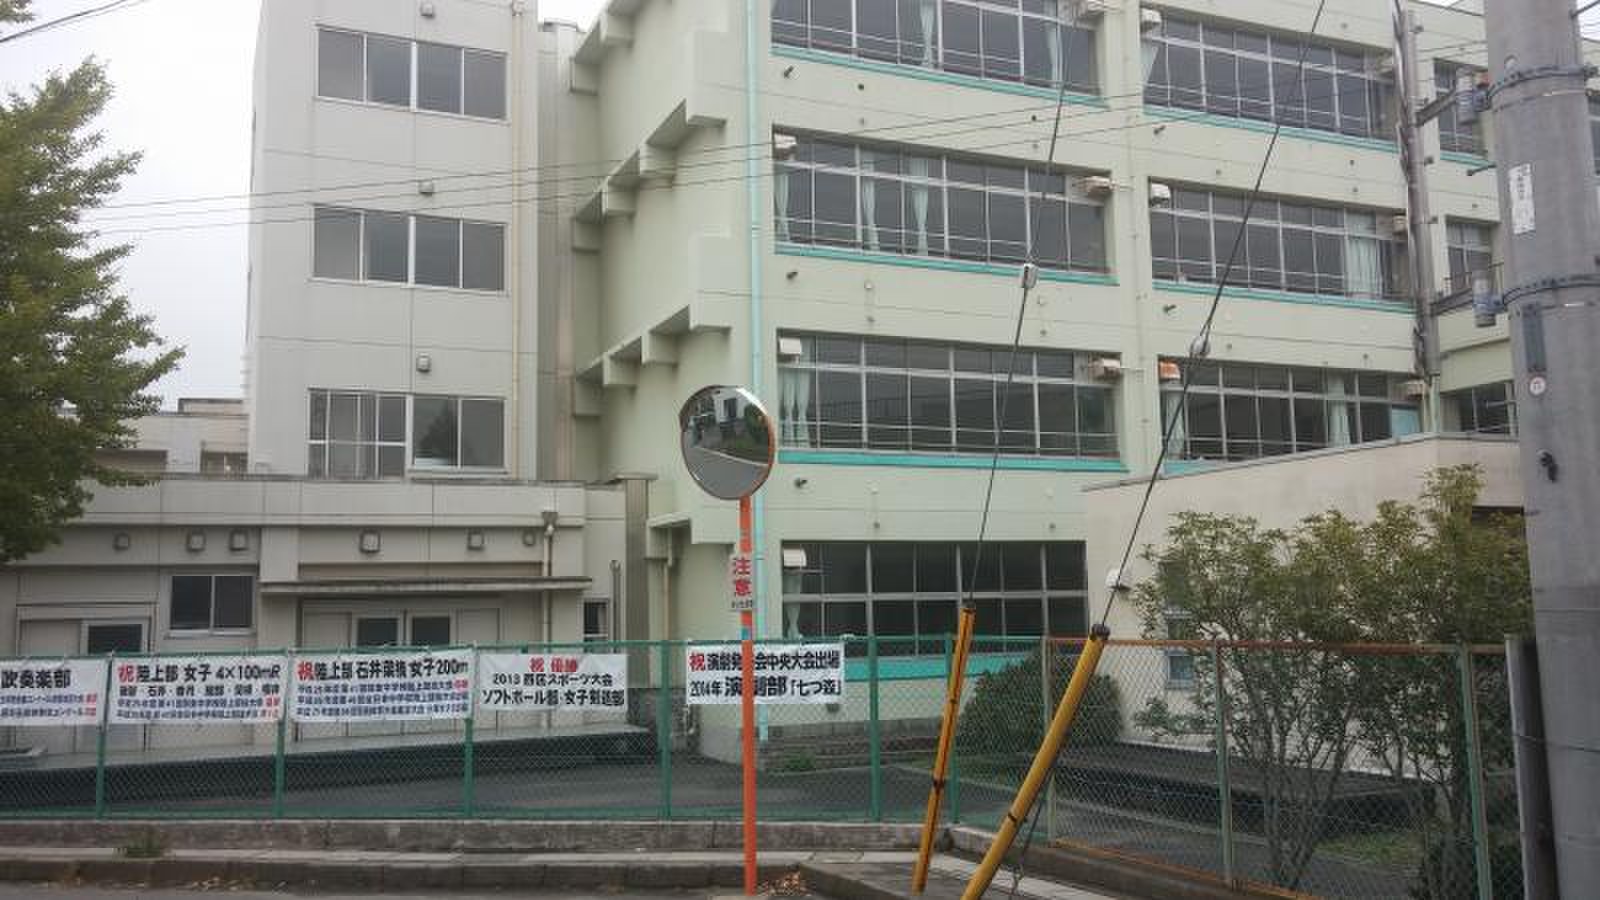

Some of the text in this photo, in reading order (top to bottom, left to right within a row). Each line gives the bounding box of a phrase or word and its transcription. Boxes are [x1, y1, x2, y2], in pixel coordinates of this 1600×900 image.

[733, 556, 752, 595] 注意
[689, 650, 839, 671] 祝演劇発会中央大会出場
[1, 669, 73, 689] 吹奏楽部
[184, 663, 212, 682] 女子
[492, 673, 521, 686] 2013
